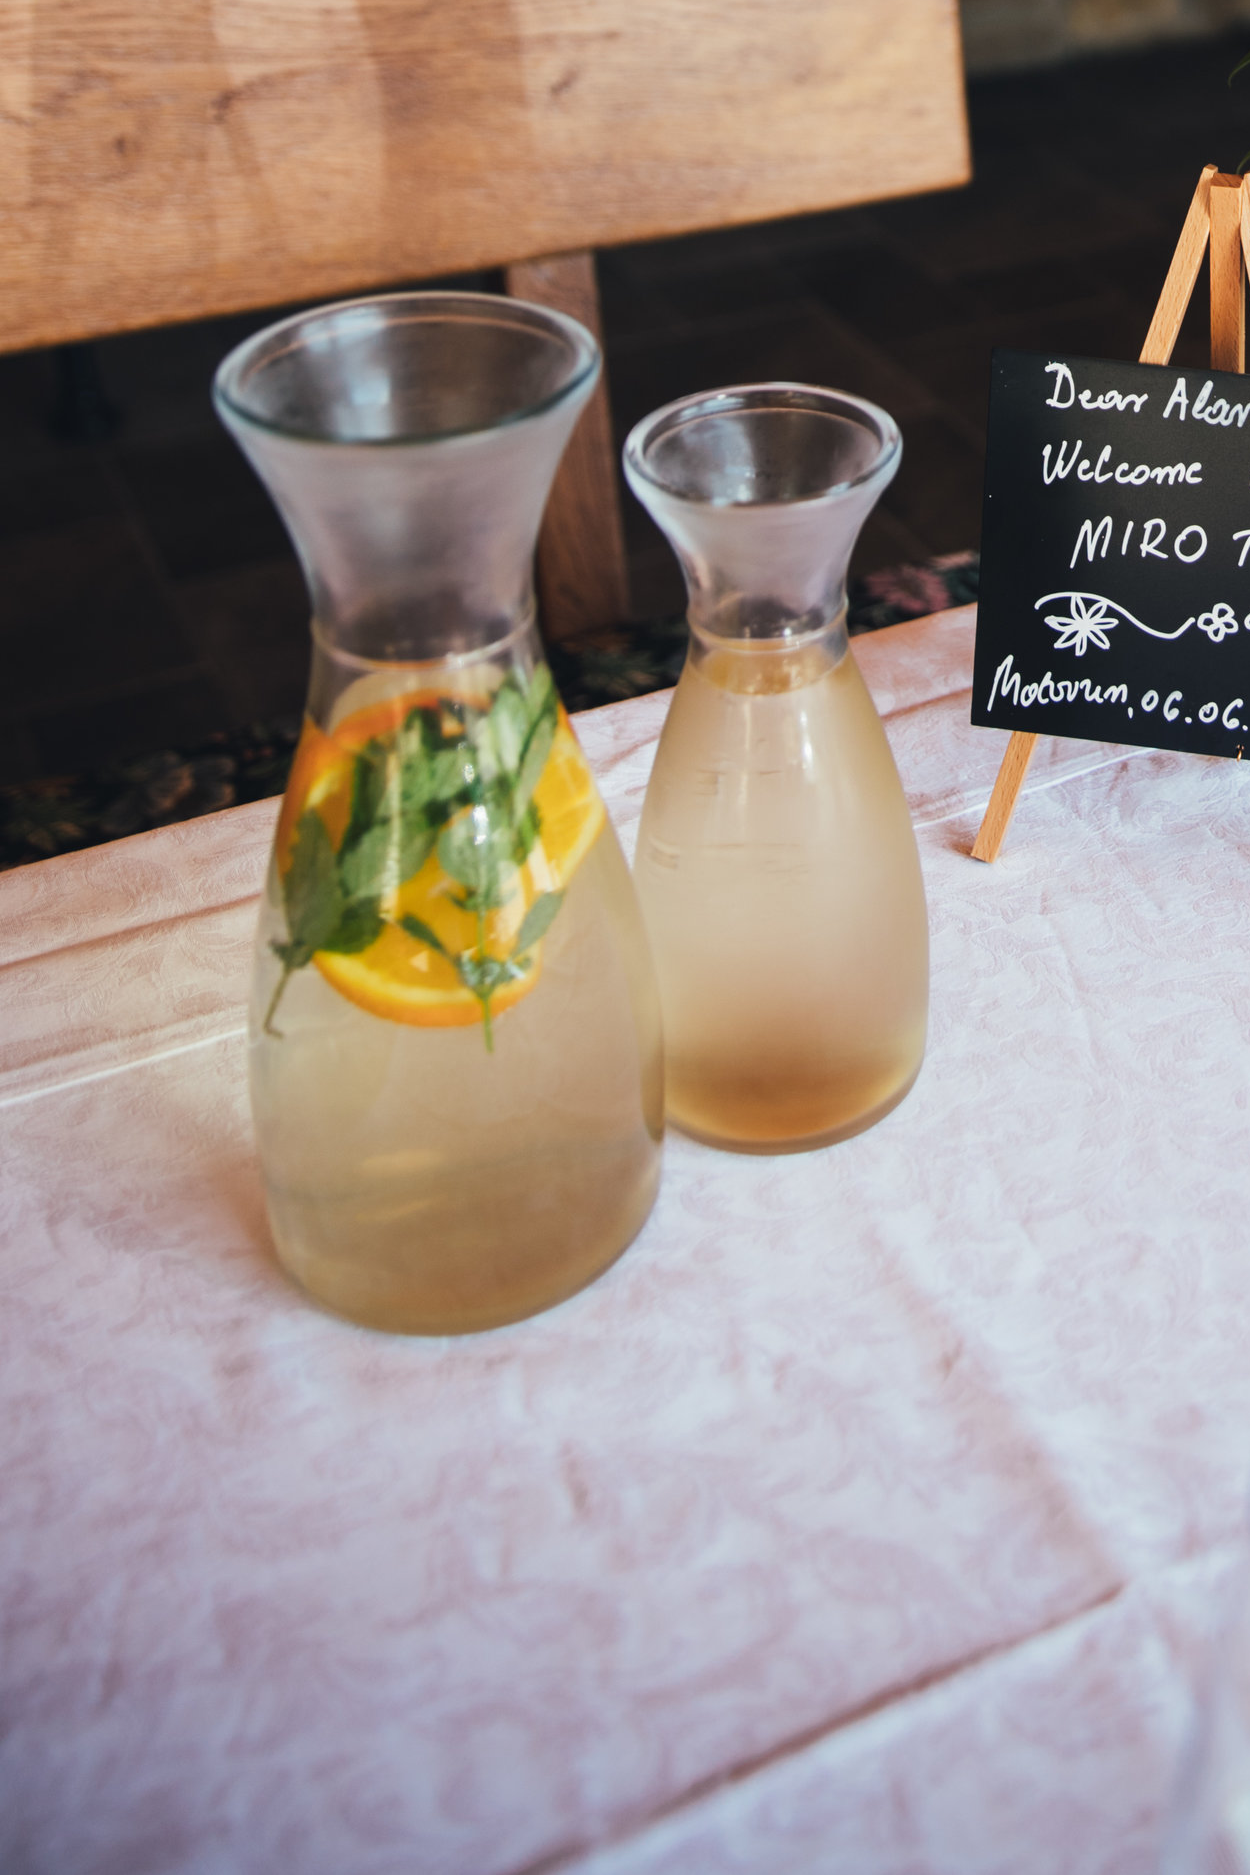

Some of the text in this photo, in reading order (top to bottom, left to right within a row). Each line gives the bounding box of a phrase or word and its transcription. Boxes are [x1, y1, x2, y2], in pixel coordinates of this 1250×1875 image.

[1044, 361, 1149, 410] Dear
[1042, 440, 1203, 485] Welcome
[1070, 516, 1208, 569] MIRO
